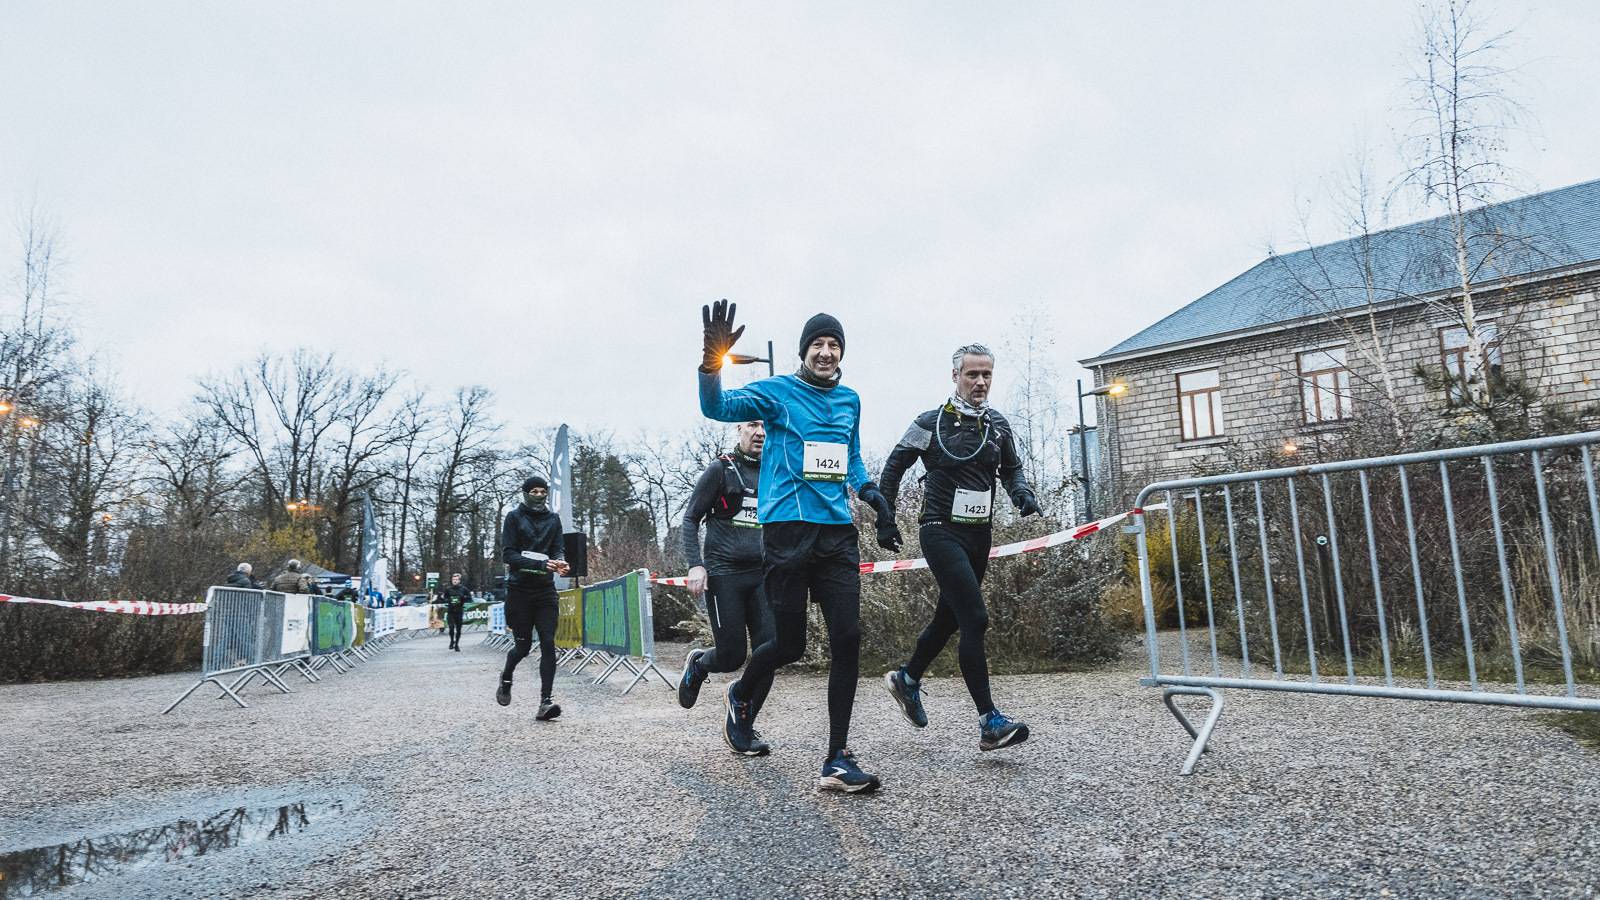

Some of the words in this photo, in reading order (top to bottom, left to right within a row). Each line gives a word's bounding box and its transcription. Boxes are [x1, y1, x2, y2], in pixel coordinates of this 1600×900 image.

[815, 458, 840, 469] 1424
[964, 504, 987, 514] 1423
[744, 510, 758, 519] 142
